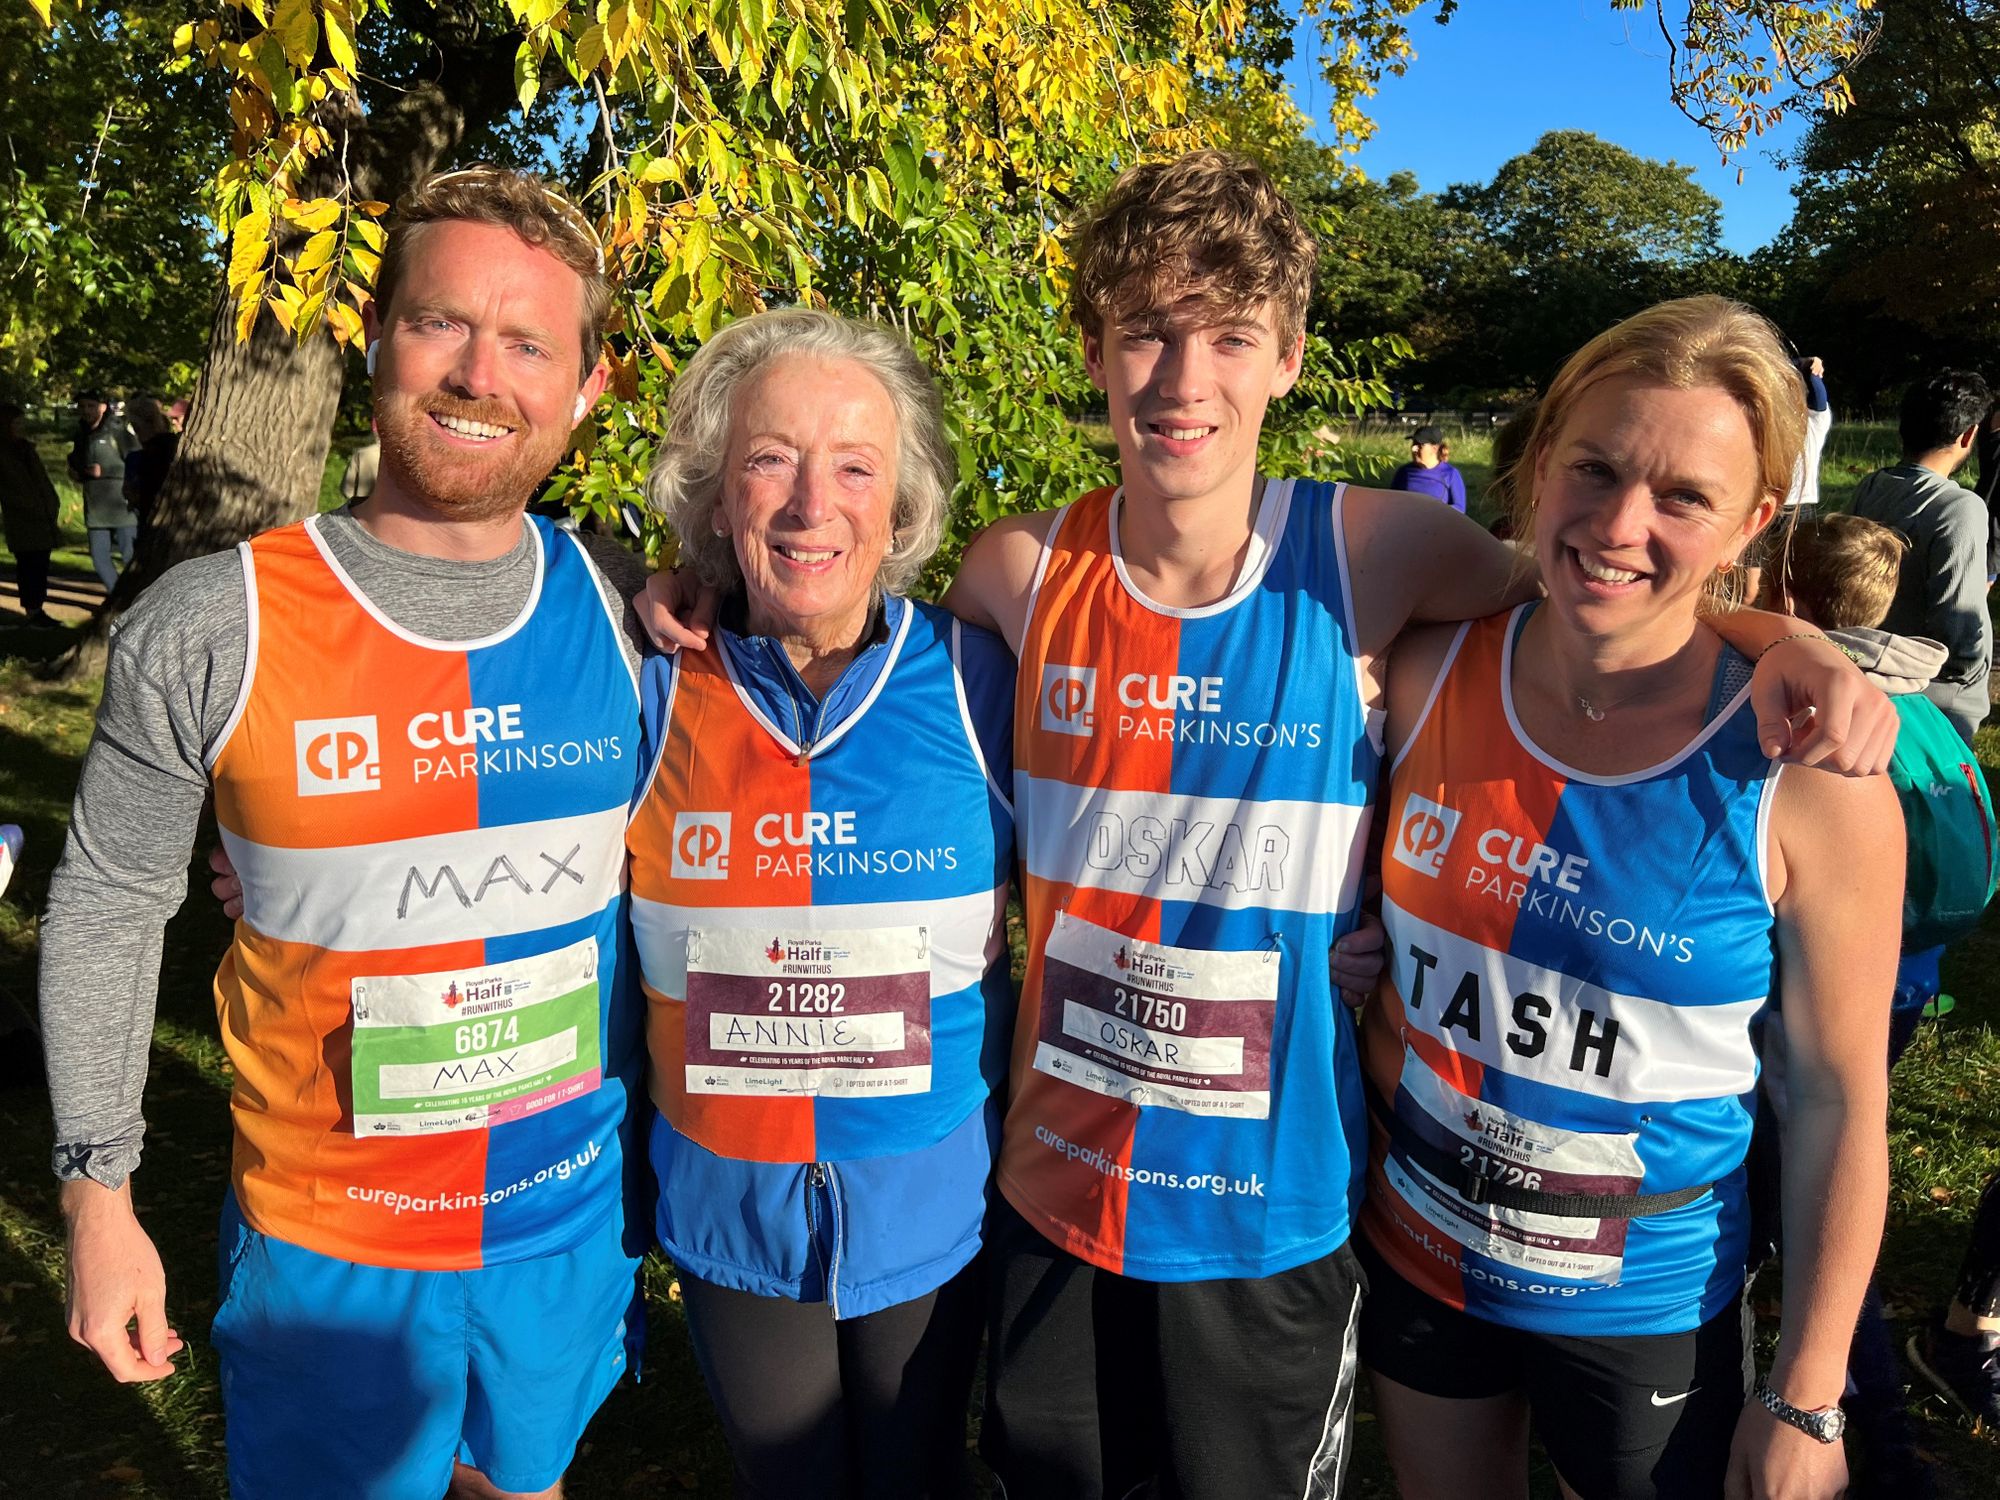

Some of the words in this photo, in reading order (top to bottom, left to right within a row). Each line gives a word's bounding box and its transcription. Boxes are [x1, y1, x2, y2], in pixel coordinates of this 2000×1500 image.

[1117, 673, 1224, 713] CURE
[407, 704, 525, 750] CURE
[1118, 715, 1321, 748] PARKINSON'S
[413, 735, 622, 784] PARKINSON'S
[754, 810, 857, 847] CURE
[755, 847, 958, 879] PARKINSON'S
[1086, 811, 1290, 893] OSKAR
[1477, 828, 1589, 894] CURE
[397, 843, 586, 919] MAX
[1465, 866, 1695, 963] PARKINSON'S
[782, 964, 832, 974] #RUNWITHUS
[787, 946, 822, 961] Half
[1132, 951, 1149, 959] Royal
[1150, 954, 1166, 963] Parks
[1132, 958, 1165, 977] Half
[465, 979, 484, 987] Royal
[466, 983, 502, 1002] Half
[768, 982, 845, 1014] 21282
[1127, 973, 1174, 992] #RUNWITHUS
[461, 998, 513, 1016] #RUNWITHUS
[1113, 987, 1187, 1032] 21750
[1409, 943, 1620, 1078] TASH
[455, 1015, 519, 1054] 6874
[433, 1052, 518, 1089] MAX
[749, 1056, 780, 1064] CELEBRATING
[836, 1055, 852, 1063] PARKS
[853, 1056, 865, 1064] HALF
[1126, 1063, 1139, 1074] YEARS
[1147, 1070, 1156, 1079] THE
[1156, 1072, 1171, 1080] ROYAL
[1172, 1075, 1188, 1083] PARKS
[744, 1077, 783, 1086] LimeLight
[849, 1080, 865, 1088] OPTED
[889, 1078, 908, 1086] T-SHIRT
[1086, 1070, 1119, 1087] LimeLight
[525, 1098, 543, 1110] GOOD
[543, 1093, 556, 1104] FOR
[562, 1081, 585, 1097] T-SHIRT
[419, 1118, 461, 1127] LimeLight
[1485, 1123, 1524, 1147] Half
[1035, 1124, 1264, 1197] cureparkinsons.org.uk
[1477, 1135, 1531, 1162] #RUNWITHUS
[346, 1140, 602, 1215] cureparkinsons.org.uk
[1460, 1144, 1542, 1191] 21726
